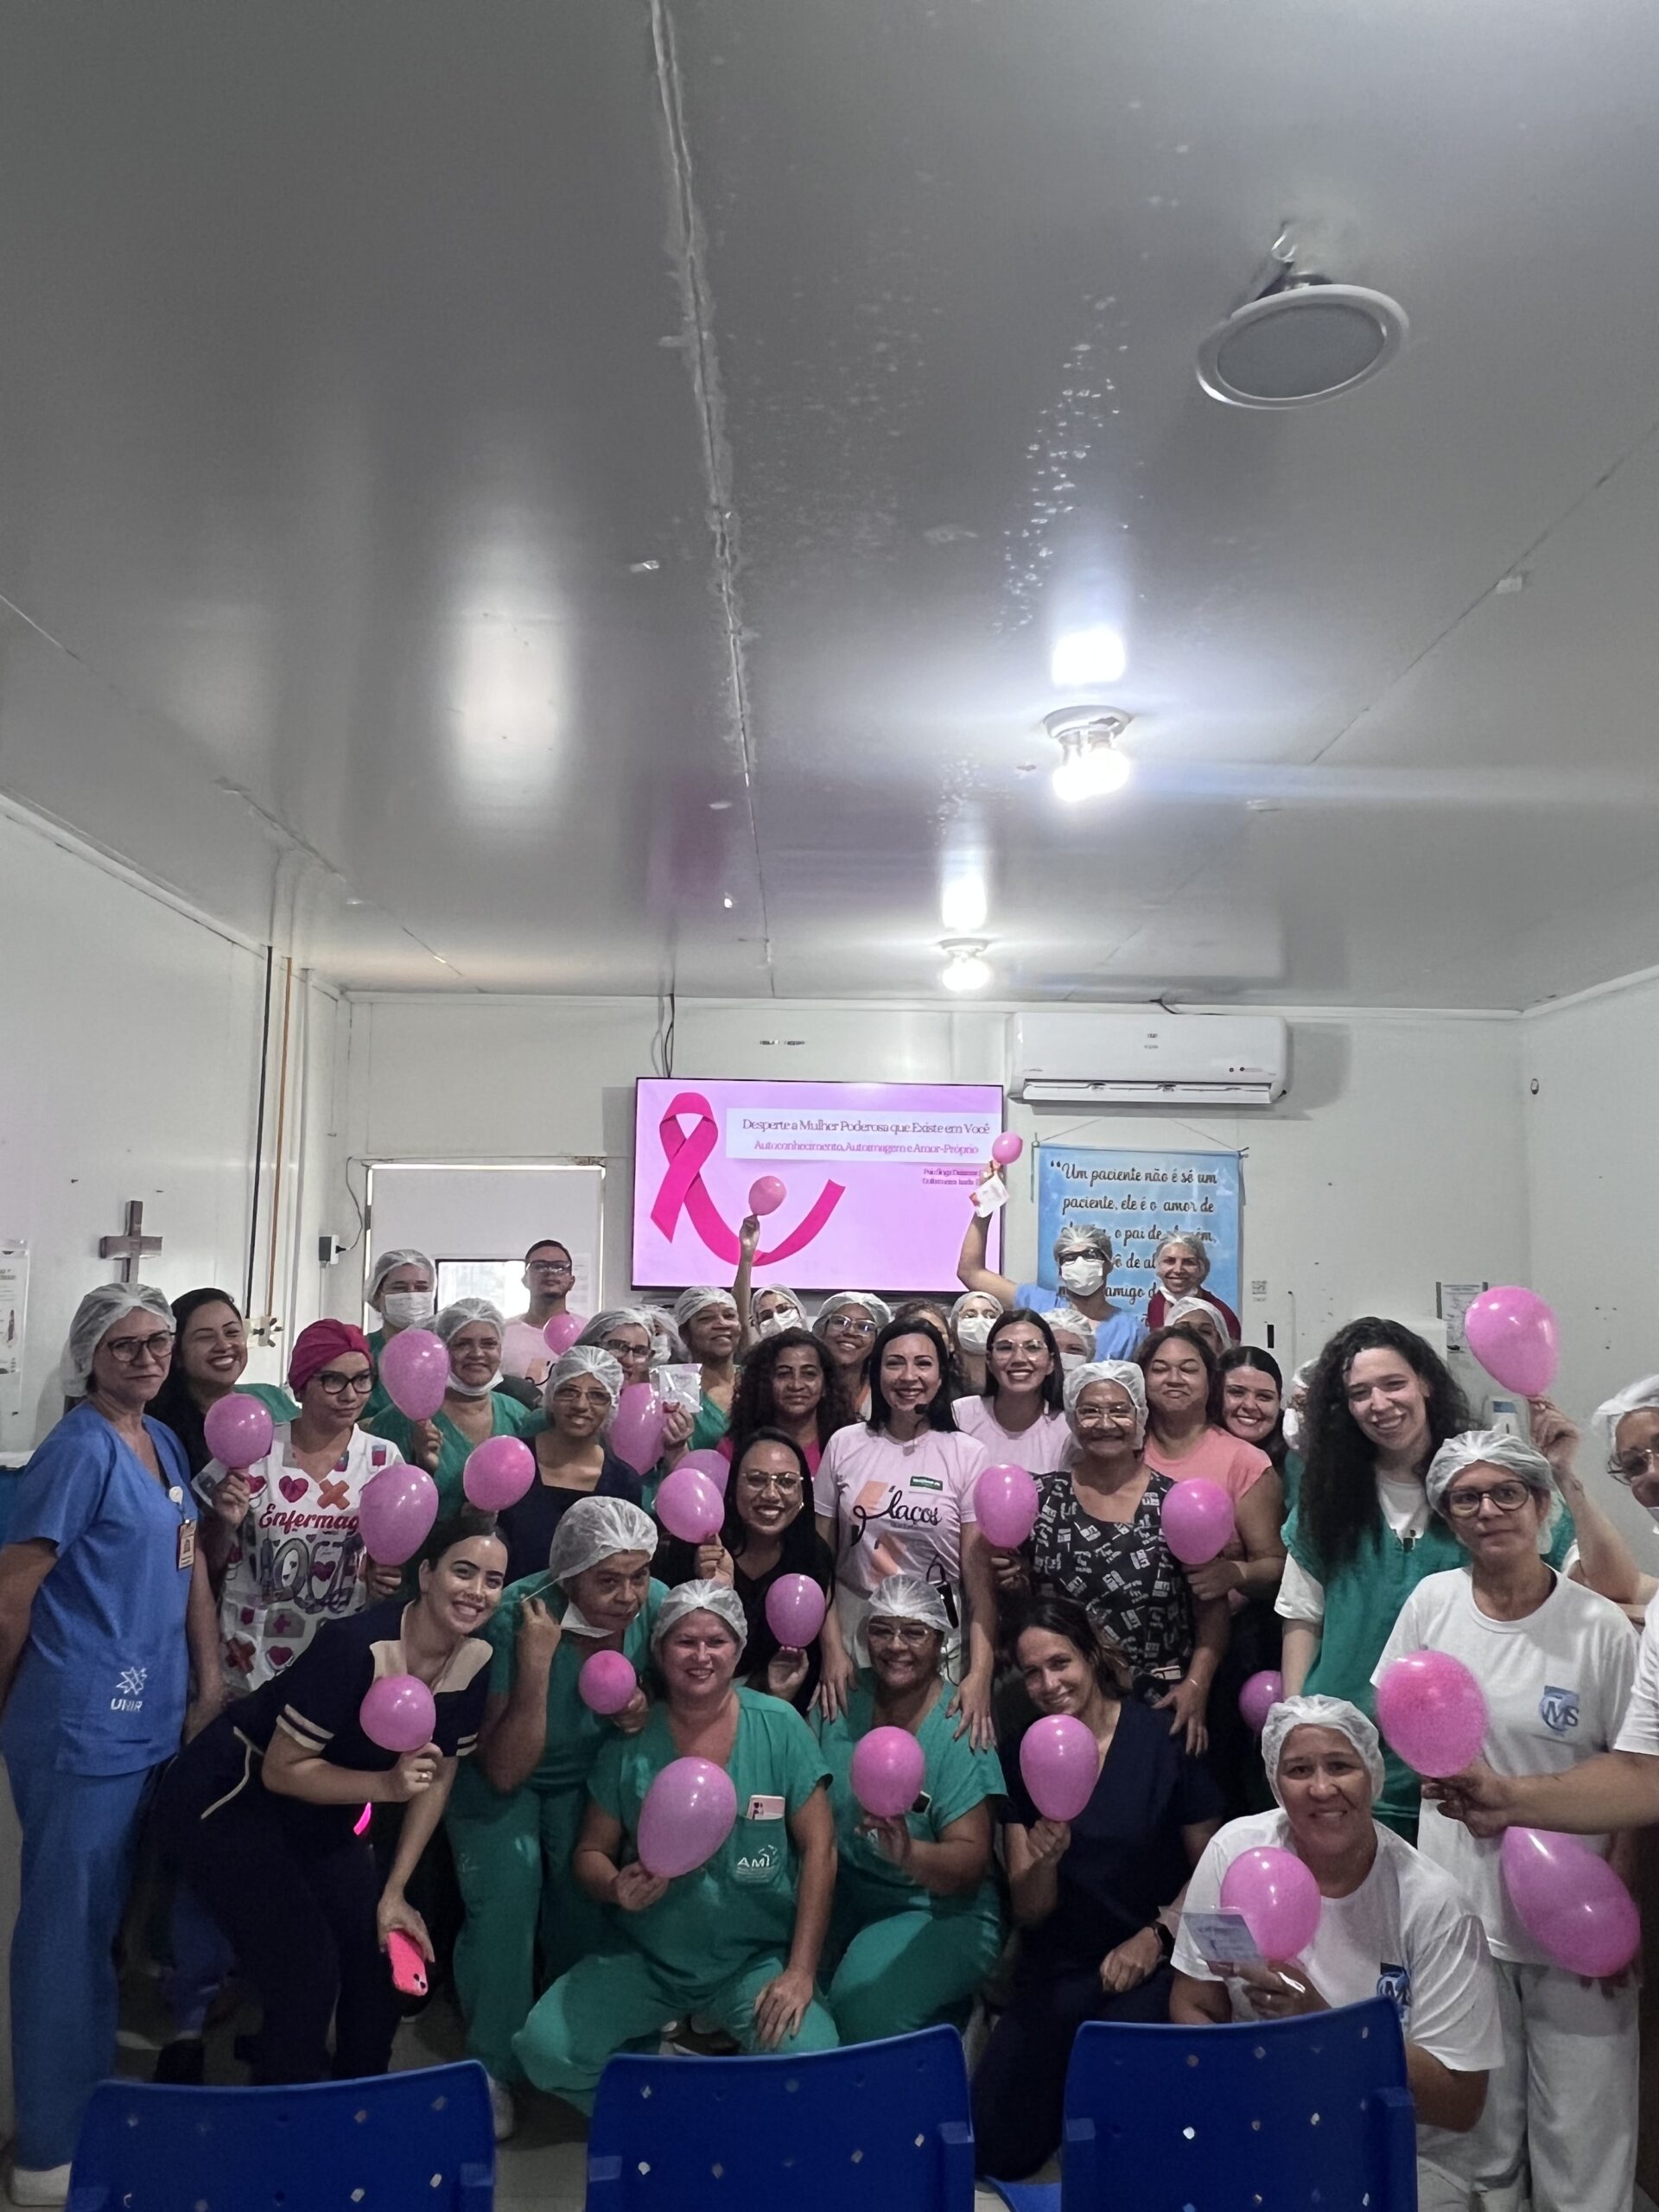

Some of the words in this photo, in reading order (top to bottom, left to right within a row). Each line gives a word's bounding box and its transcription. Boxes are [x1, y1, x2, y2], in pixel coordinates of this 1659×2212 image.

[742, 1119, 791, 1132] Desperte
[841, 1121, 888, 1132] Poderosa
[890, 1124, 911, 1135] que
[912, 1122, 944, 1134] Existe
[944, 1125, 963, 1134] em
[963, 1123, 990, 1135] Você
[1090, 1166, 1142, 1187] paciente
[1145, 1168, 1168, 1183] não
[1171, 1168, 1179, 1183] é
[1197, 1173, 1217, 1184] um
[1061, 1195, 1118, 1216] paciente,
[1121, 1194, 1138, 1211] ele
[1141, 1196, 1147, 1211] é
[1149, 1201, 1157, 1211] o
[1163, 1201, 1198, 1212] amor
[1199, 1196, 1215, 1212] de
[1115, 1229, 1122, 1238] o
[1124, 1228, 1145, 1246] pai
[1147, 1224, 1162, 1241] de
[1126, 1252, 1141, 1268] de
[1105, 1285, 1146, 1306] amigo
